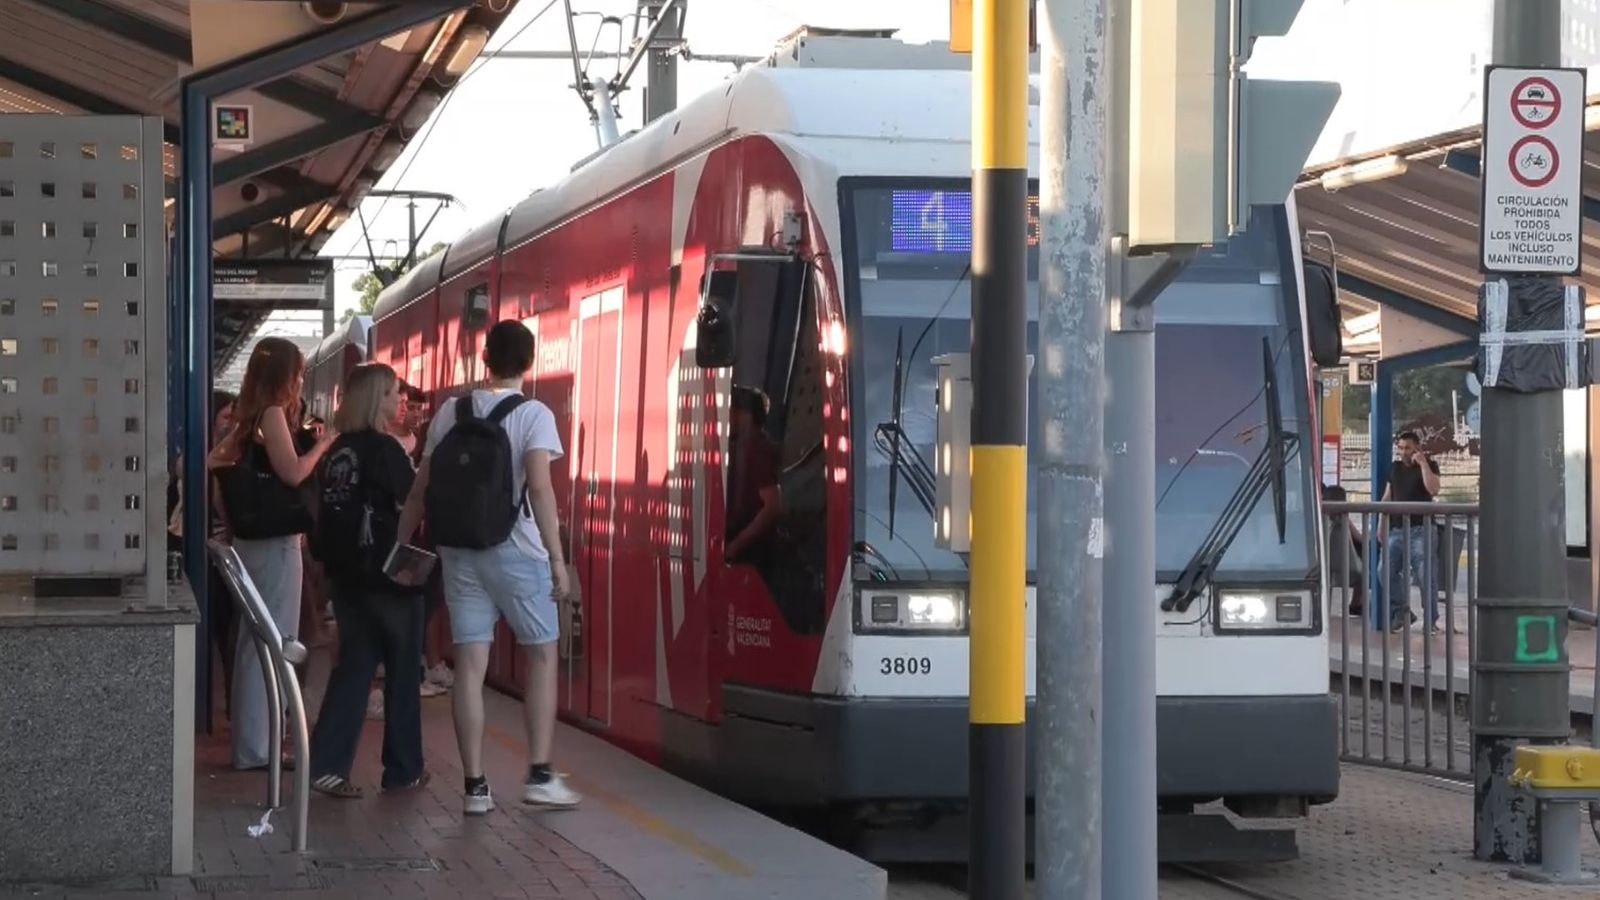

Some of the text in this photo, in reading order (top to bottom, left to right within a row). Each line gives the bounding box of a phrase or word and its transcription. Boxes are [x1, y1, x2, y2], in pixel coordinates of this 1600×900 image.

[1497, 194, 1568, 207] CIRCULACIÓN
[1504, 207, 1560, 219] PROHIBIDA
[921, 191, 945, 251] 4
[1515, 220, 1551, 230] TODOS
[1490, 230, 1573, 242] LOS VEHÍCULOS
[1508, 243, 1554, 253] INCLUSO
[1488, 254, 1575, 266] MANTENIMIENTO
[736, 616, 771, 631] GENERALITAT
[736, 631, 771, 648] VALENCIANA
[880, 657, 931, 675] 3809
